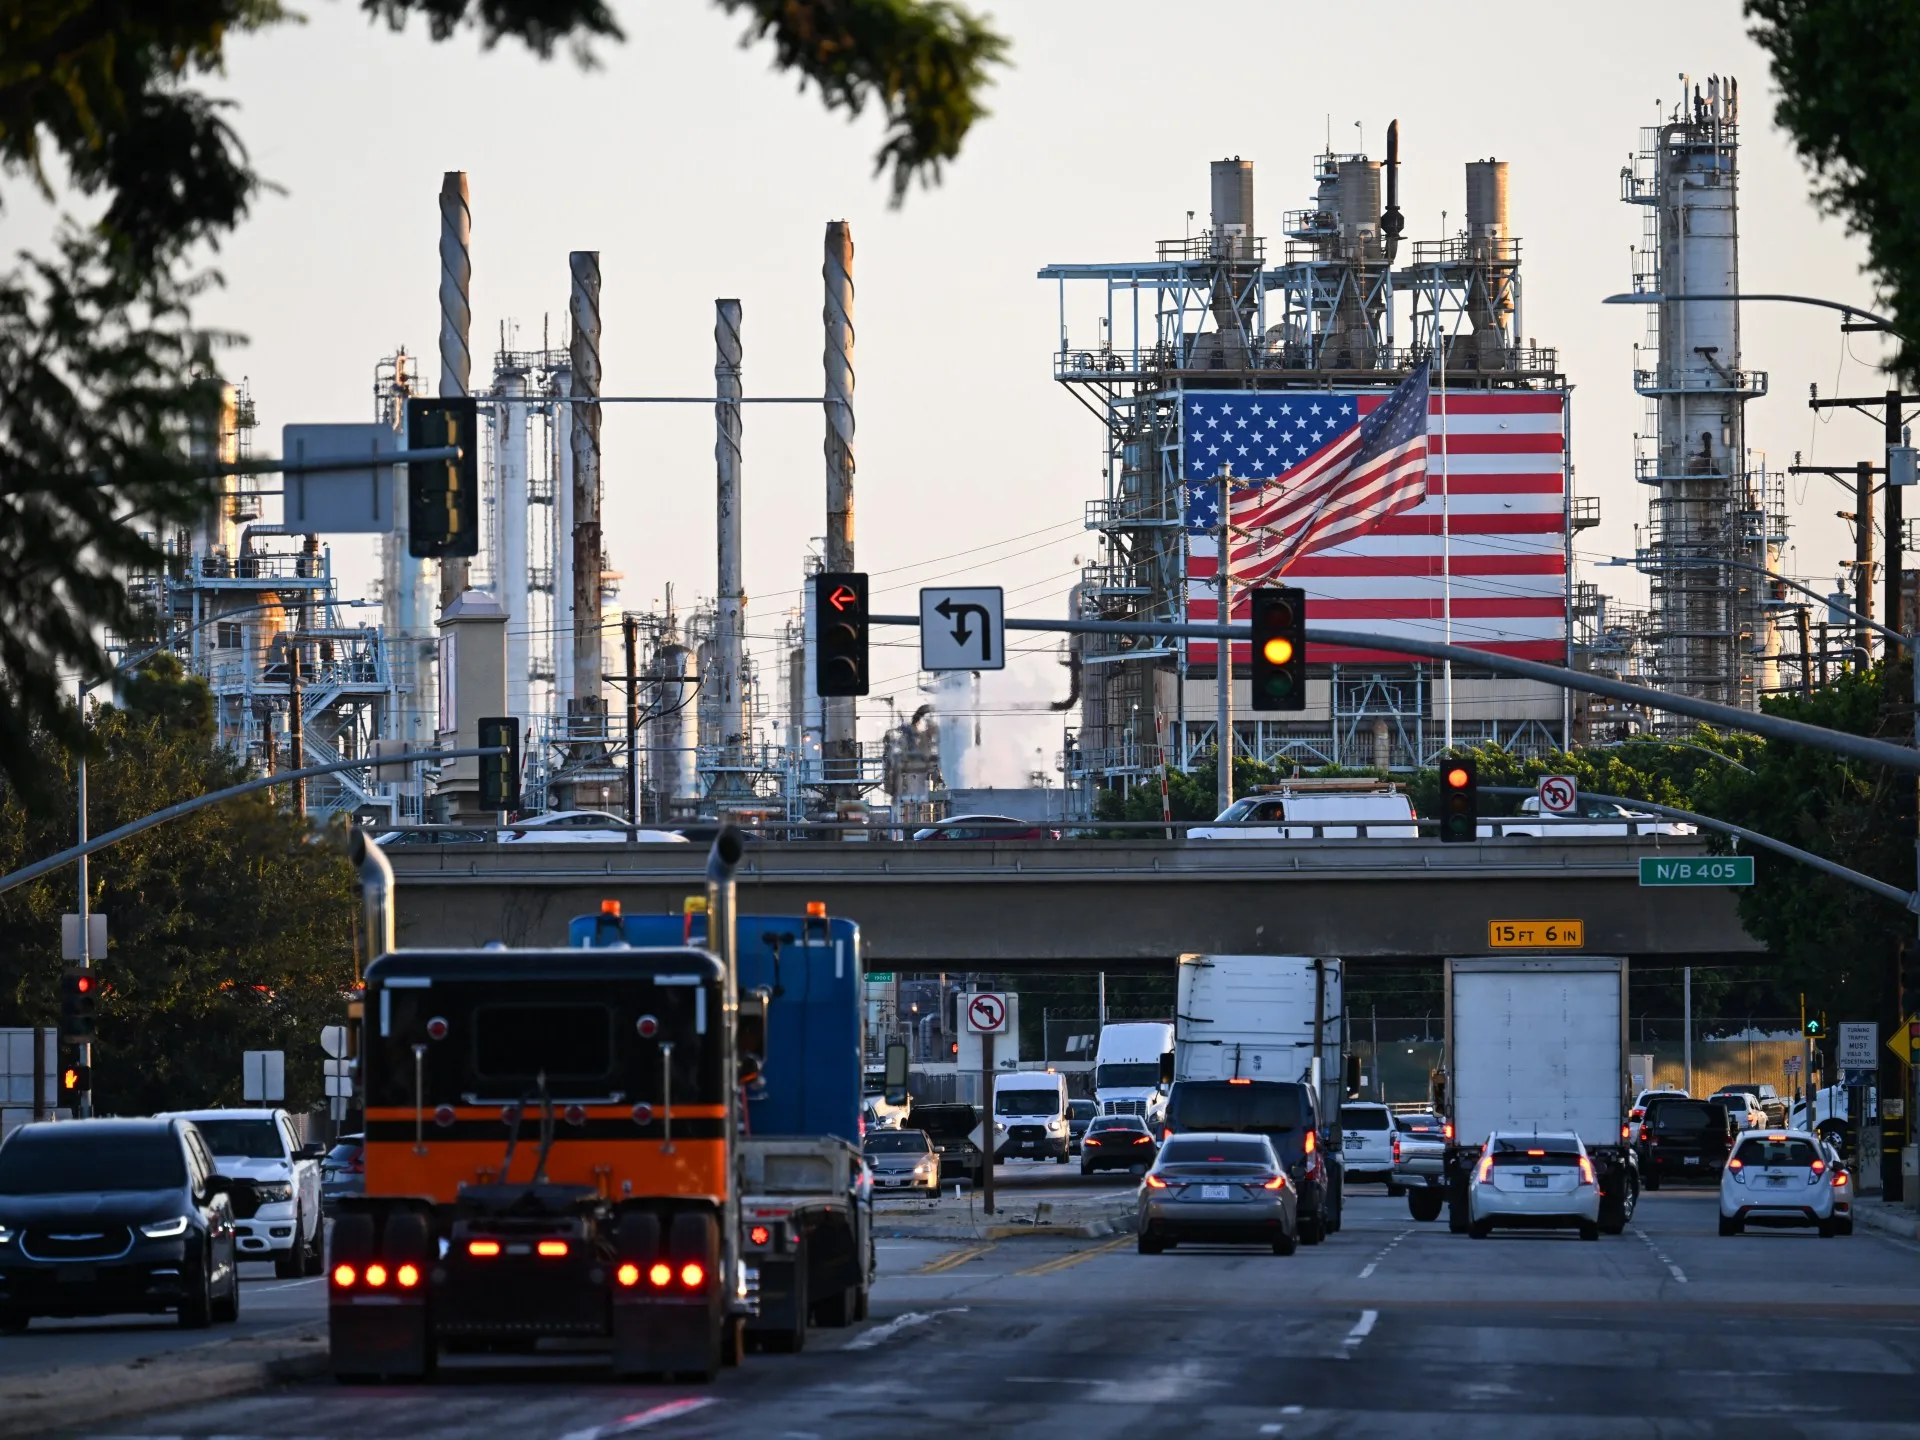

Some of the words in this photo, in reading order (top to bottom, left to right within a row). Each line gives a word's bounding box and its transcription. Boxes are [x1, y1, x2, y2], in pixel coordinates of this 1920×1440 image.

[1657, 863, 1692, 880] N/B
[1696, 864, 1736, 878] 405
[1496, 926, 1515, 942] 15
[1518, 931, 1534, 942] FT
[1545, 926, 1558, 942] 6
[1563, 931, 1576, 942] IN
